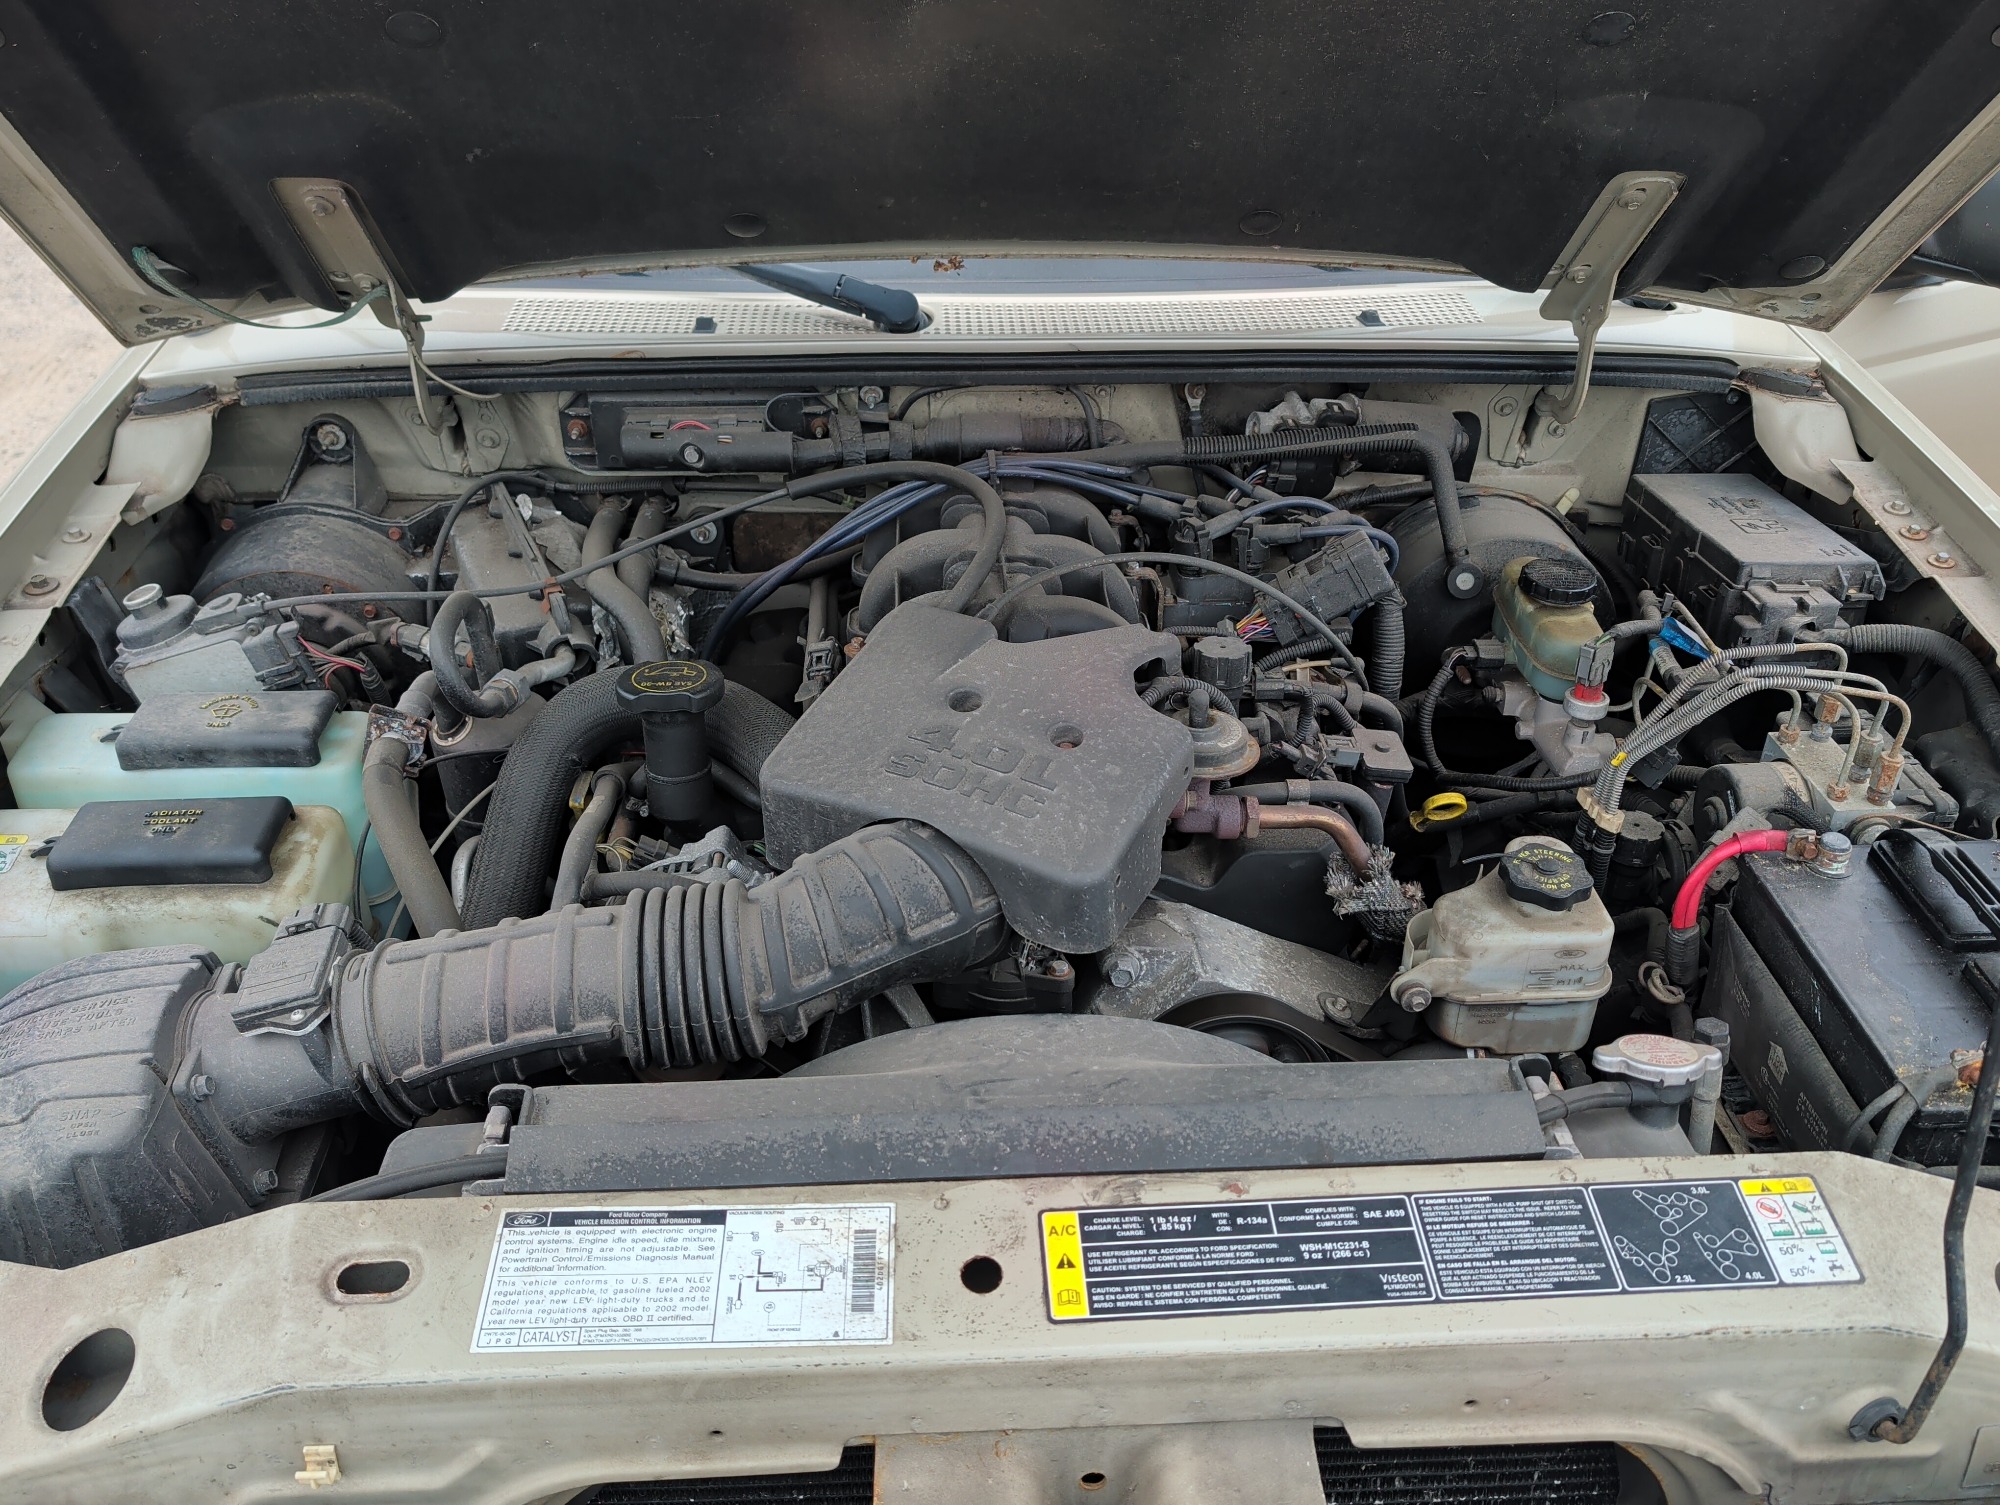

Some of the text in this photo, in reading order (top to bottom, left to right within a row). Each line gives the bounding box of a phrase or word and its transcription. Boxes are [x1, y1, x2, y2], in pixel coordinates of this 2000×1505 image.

[908, 725, 1057, 791] 4.0L
[884, 752, 1046, 818] SOHC
[144, 809, 204, 817] RADIATOR
[143, 818, 198, 826] COOLANT
[1534, 848, 1573, 863] STEERING
[1560, 963, 1585, 971] MAX
[59, 1109, 101, 1121] SNAP
[1690, 1186, 1710, 1194] 3.0L
[1237, 1217, 1268, 1225] R-134a
[576, 1228, 616, 1237] equipped
[688, 1227, 717, 1235] engine
[1048, 1225, 1076, 1236] A/C
[1159, 1223, 1185, 1232] .85 kg
[579, 1237, 608, 1246] Engine
[631, 1237, 659, 1245] speed,
[1300, 1241, 1370, 1251] WSH-M1C231-B
[526, 1247, 559, 1255] ignition
[1103, 1249, 1147, 1257] REFRIGERANT
[1161, 1246, 1199, 1254] ACCORDING
[1779, 1245, 1804, 1255] 50%
[635, 1254, 678, 1262] Diagnosis
[1303, 1252, 1309, 1260] 9
[1745, 1272, 1765, 1280] 4.0L
[1790, 1266, 1815, 1277] 50%
[1379, 1272, 1424, 1283] Visteon
[1674, 1274, 1696, 1282] 2.3L
[1217, 1280, 1251, 1288] QUALIFIED
[494, 1289, 544, 1297] regulations
[550, 1288, 594, 1296] applicable
[613, 1287, 651, 1295] gasoline
[597, 1297, 640, 1305] light-duty
[538, 1307, 587, 1315] regulations
[592, 1306, 637, 1314] applicable
[550, 1316, 588, 1325] light-duty
